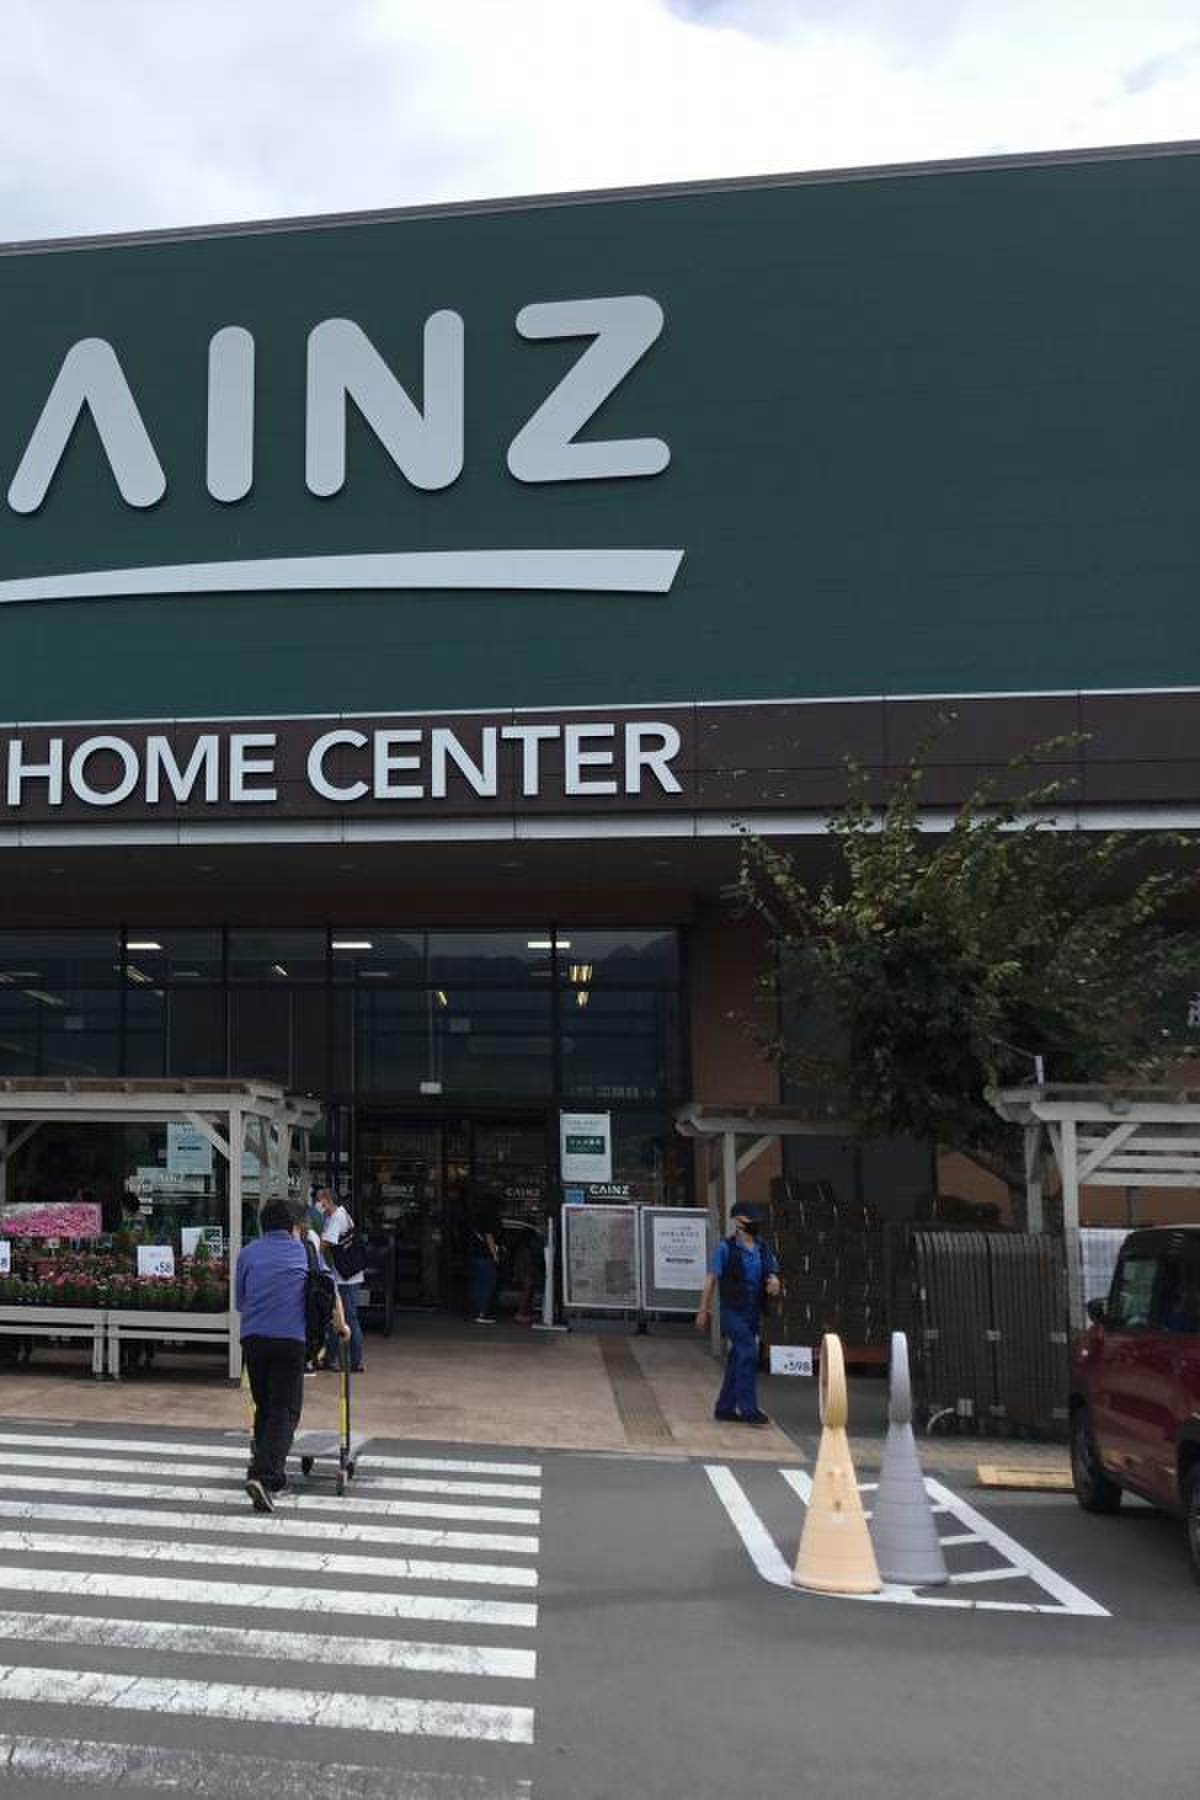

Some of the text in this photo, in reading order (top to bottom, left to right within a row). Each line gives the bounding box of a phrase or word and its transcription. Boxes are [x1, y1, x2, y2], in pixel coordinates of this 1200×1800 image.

[6, 732, 279, 807] HOME
[306, 720, 685, 803] CENTER
[589, 1183, 631, 1196] CAINZ
